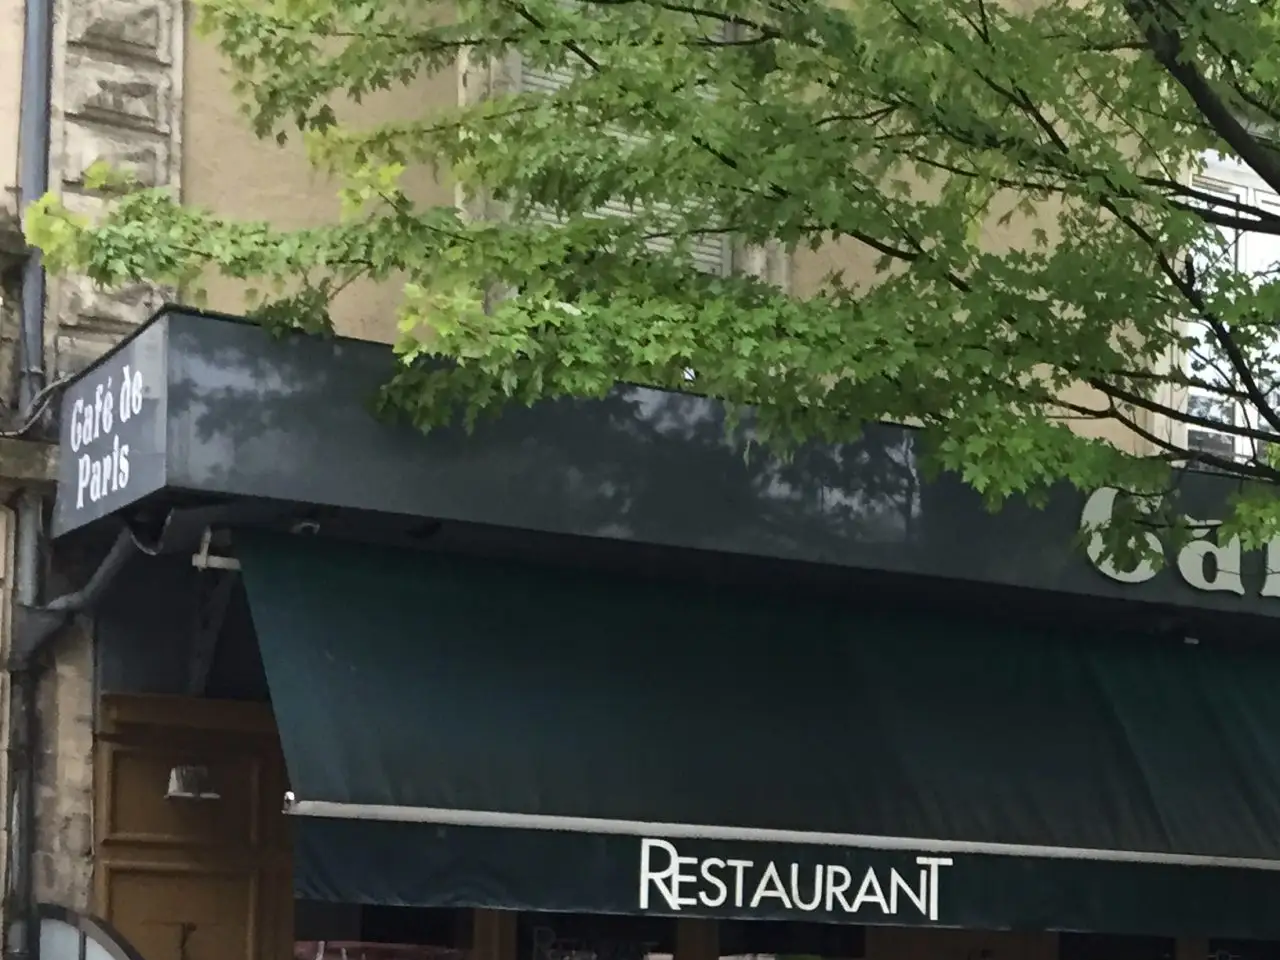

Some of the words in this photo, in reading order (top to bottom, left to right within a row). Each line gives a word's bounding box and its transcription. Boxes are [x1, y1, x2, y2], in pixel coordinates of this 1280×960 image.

[70, 377, 114, 453] Café
[119, 364, 144, 424] de
[76, 434, 130, 510] Paris
[640, 837, 954, 921] RESTAURANT
